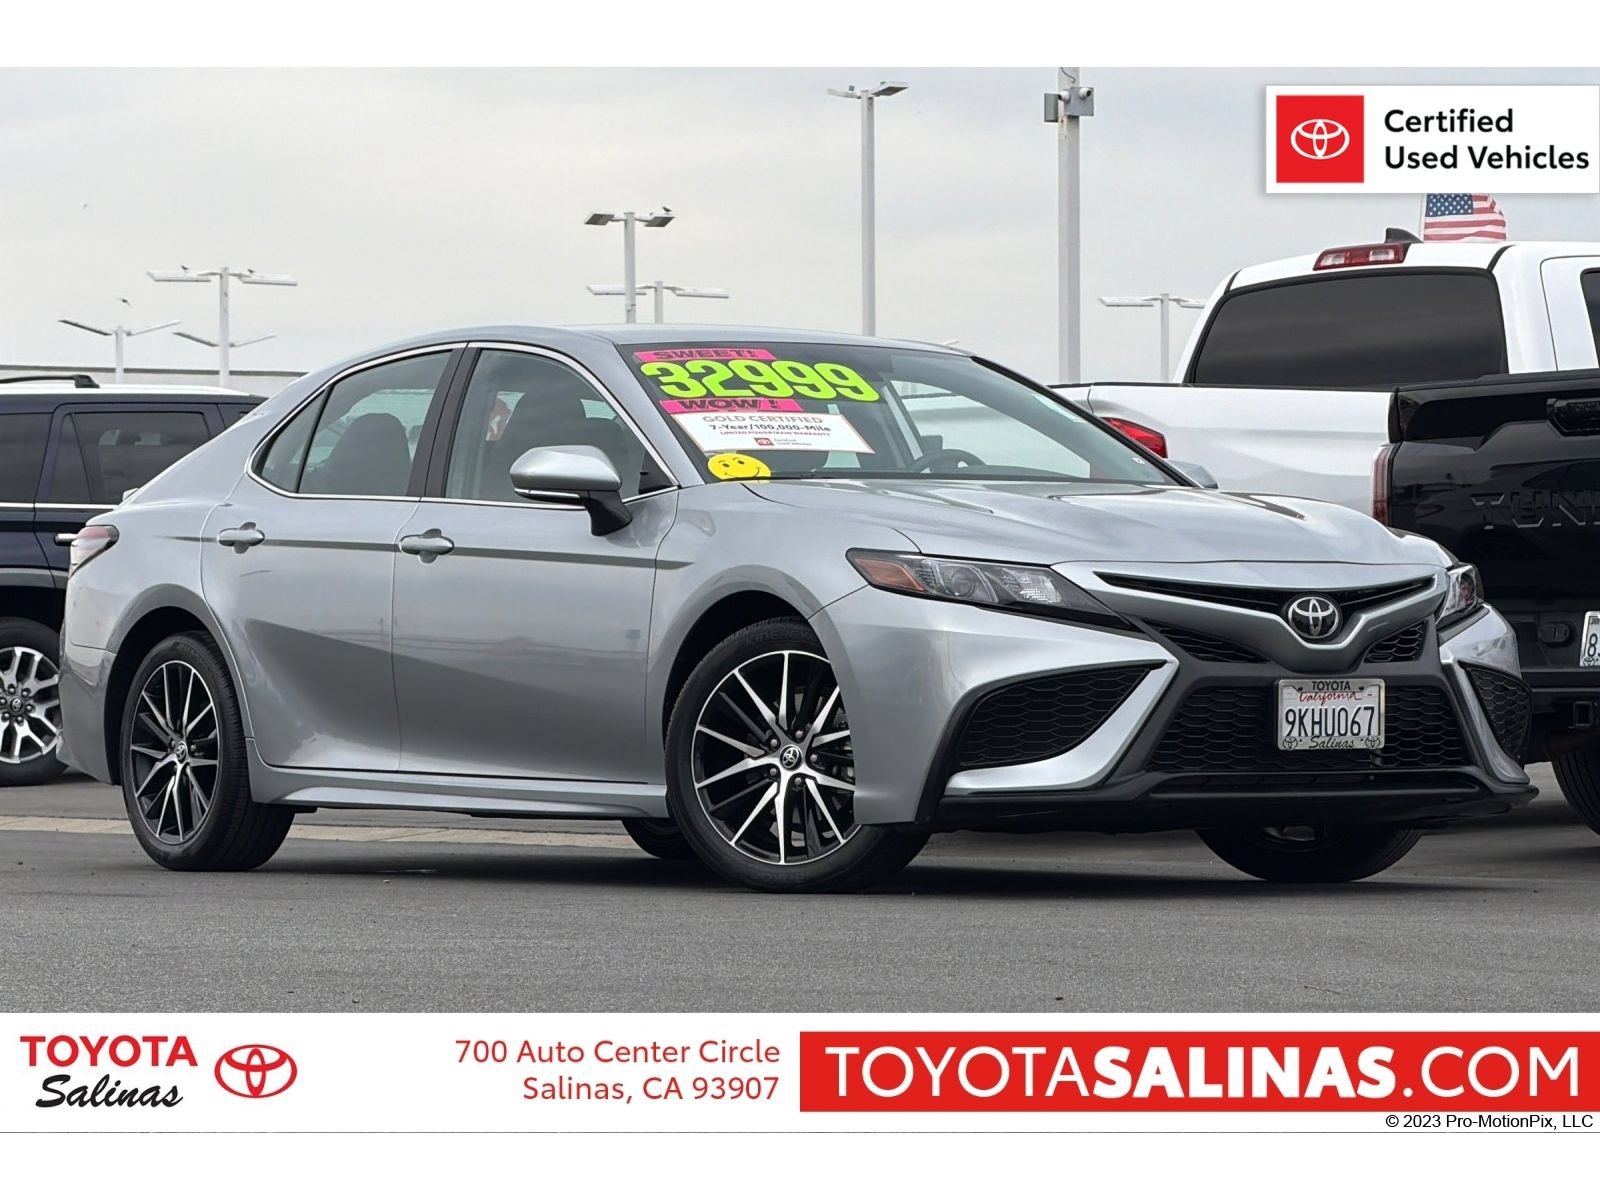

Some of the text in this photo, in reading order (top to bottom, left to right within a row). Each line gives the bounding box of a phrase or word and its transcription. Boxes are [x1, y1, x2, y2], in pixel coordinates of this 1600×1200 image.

[653, 349, 756, 360] SWEET!
[640, 359, 880, 402] 32999
[702, 415, 824, 424] GOLD CERTIFIED
[1469, 490, 1600, 530] TUN
[1311, 681, 1351, 691] TOYOTA
[1298, 692, 1363, 706] California
[1285, 706, 1375, 737] 9KHU067
[1309, 736, 1355, 749] Salinas
